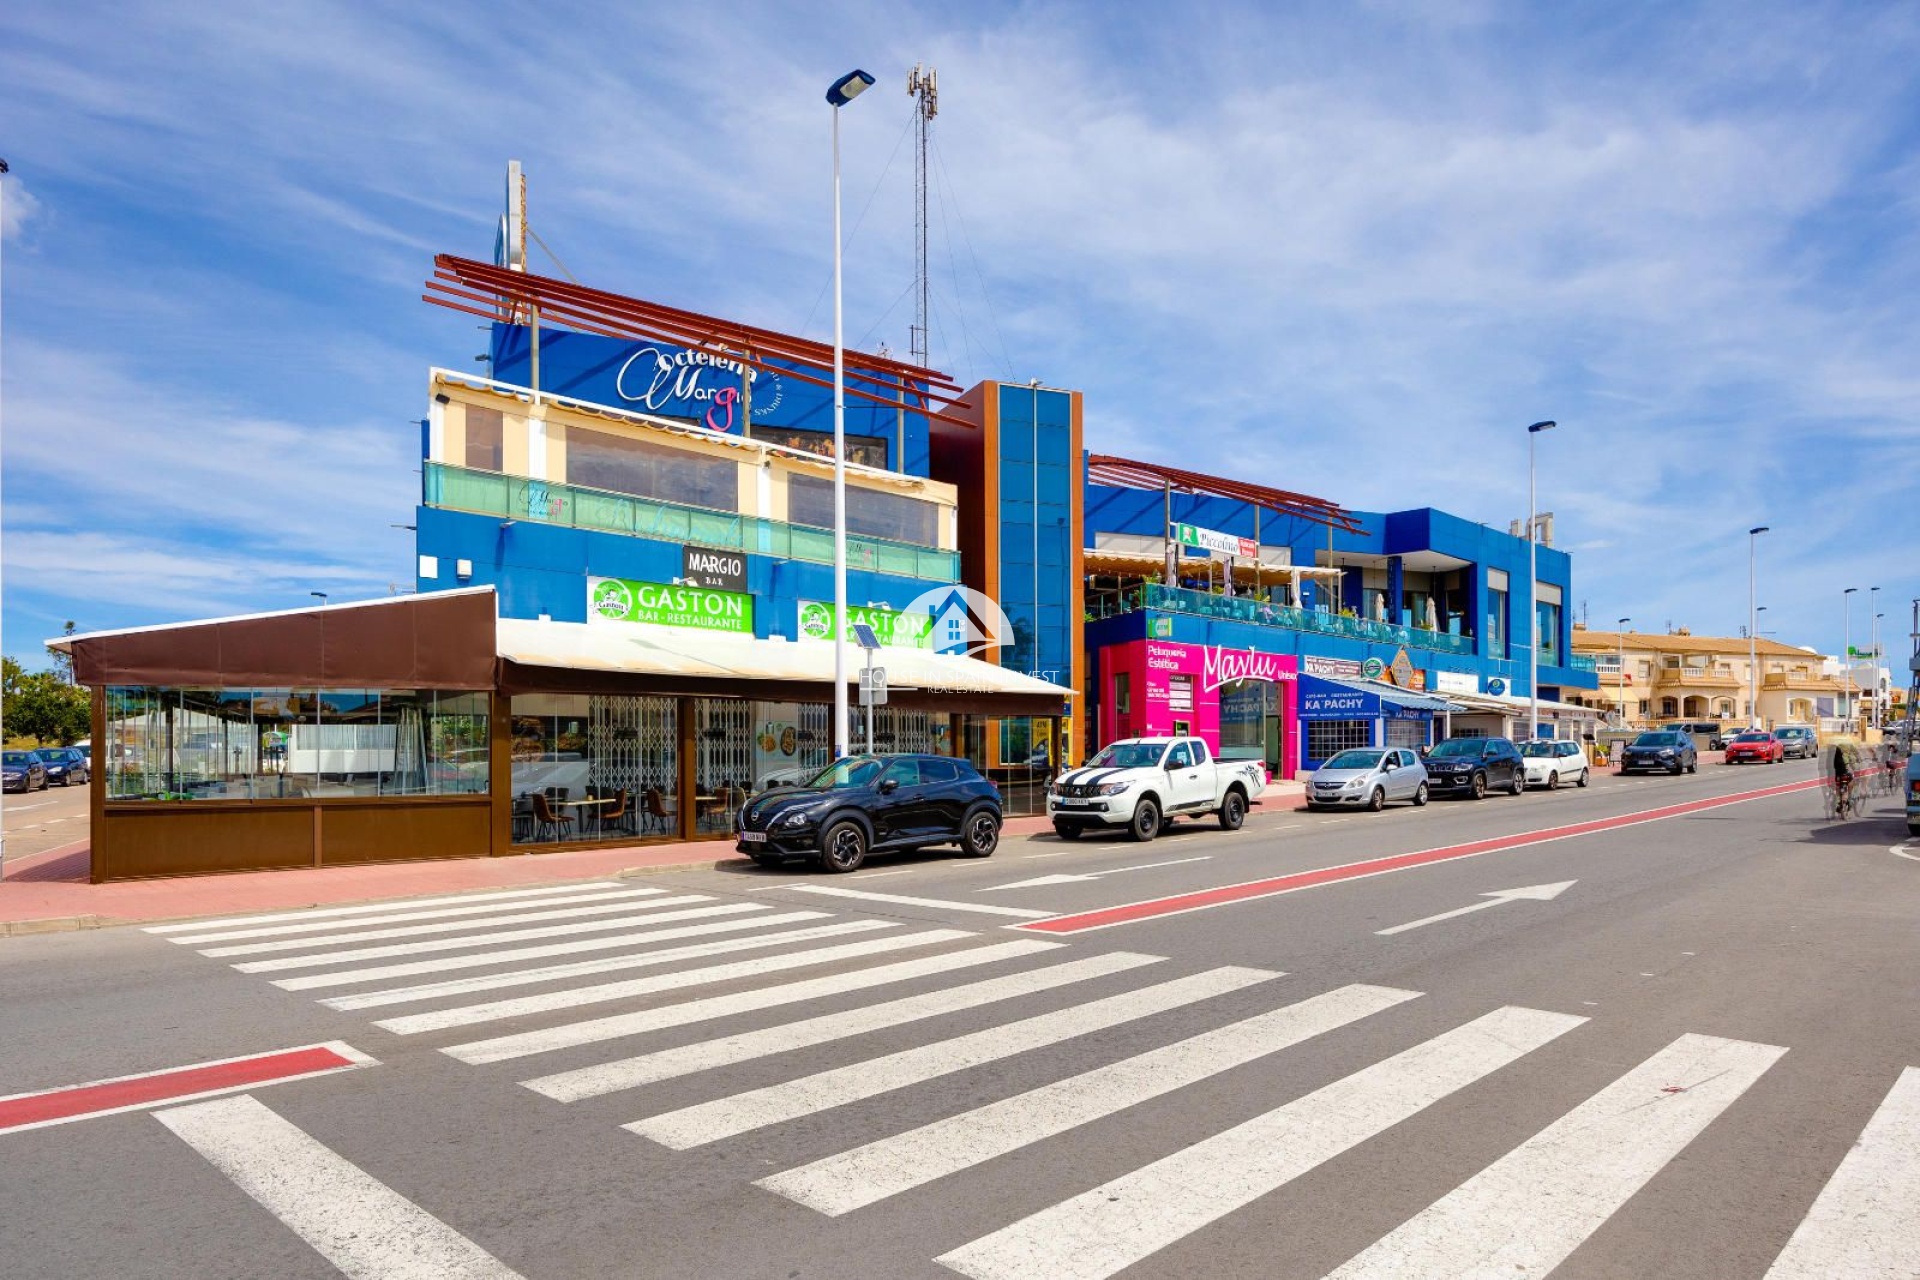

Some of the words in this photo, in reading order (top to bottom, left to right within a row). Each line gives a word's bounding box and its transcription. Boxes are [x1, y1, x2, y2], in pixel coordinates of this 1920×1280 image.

[688, 552, 741, 576] MARGIO
[705, 577, 723, 586] BAR
[638, 586, 743, 617] GASTON
[667, 612, 743, 630] RESTAURANTE
[1203, 644, 1277, 693] Maylu
